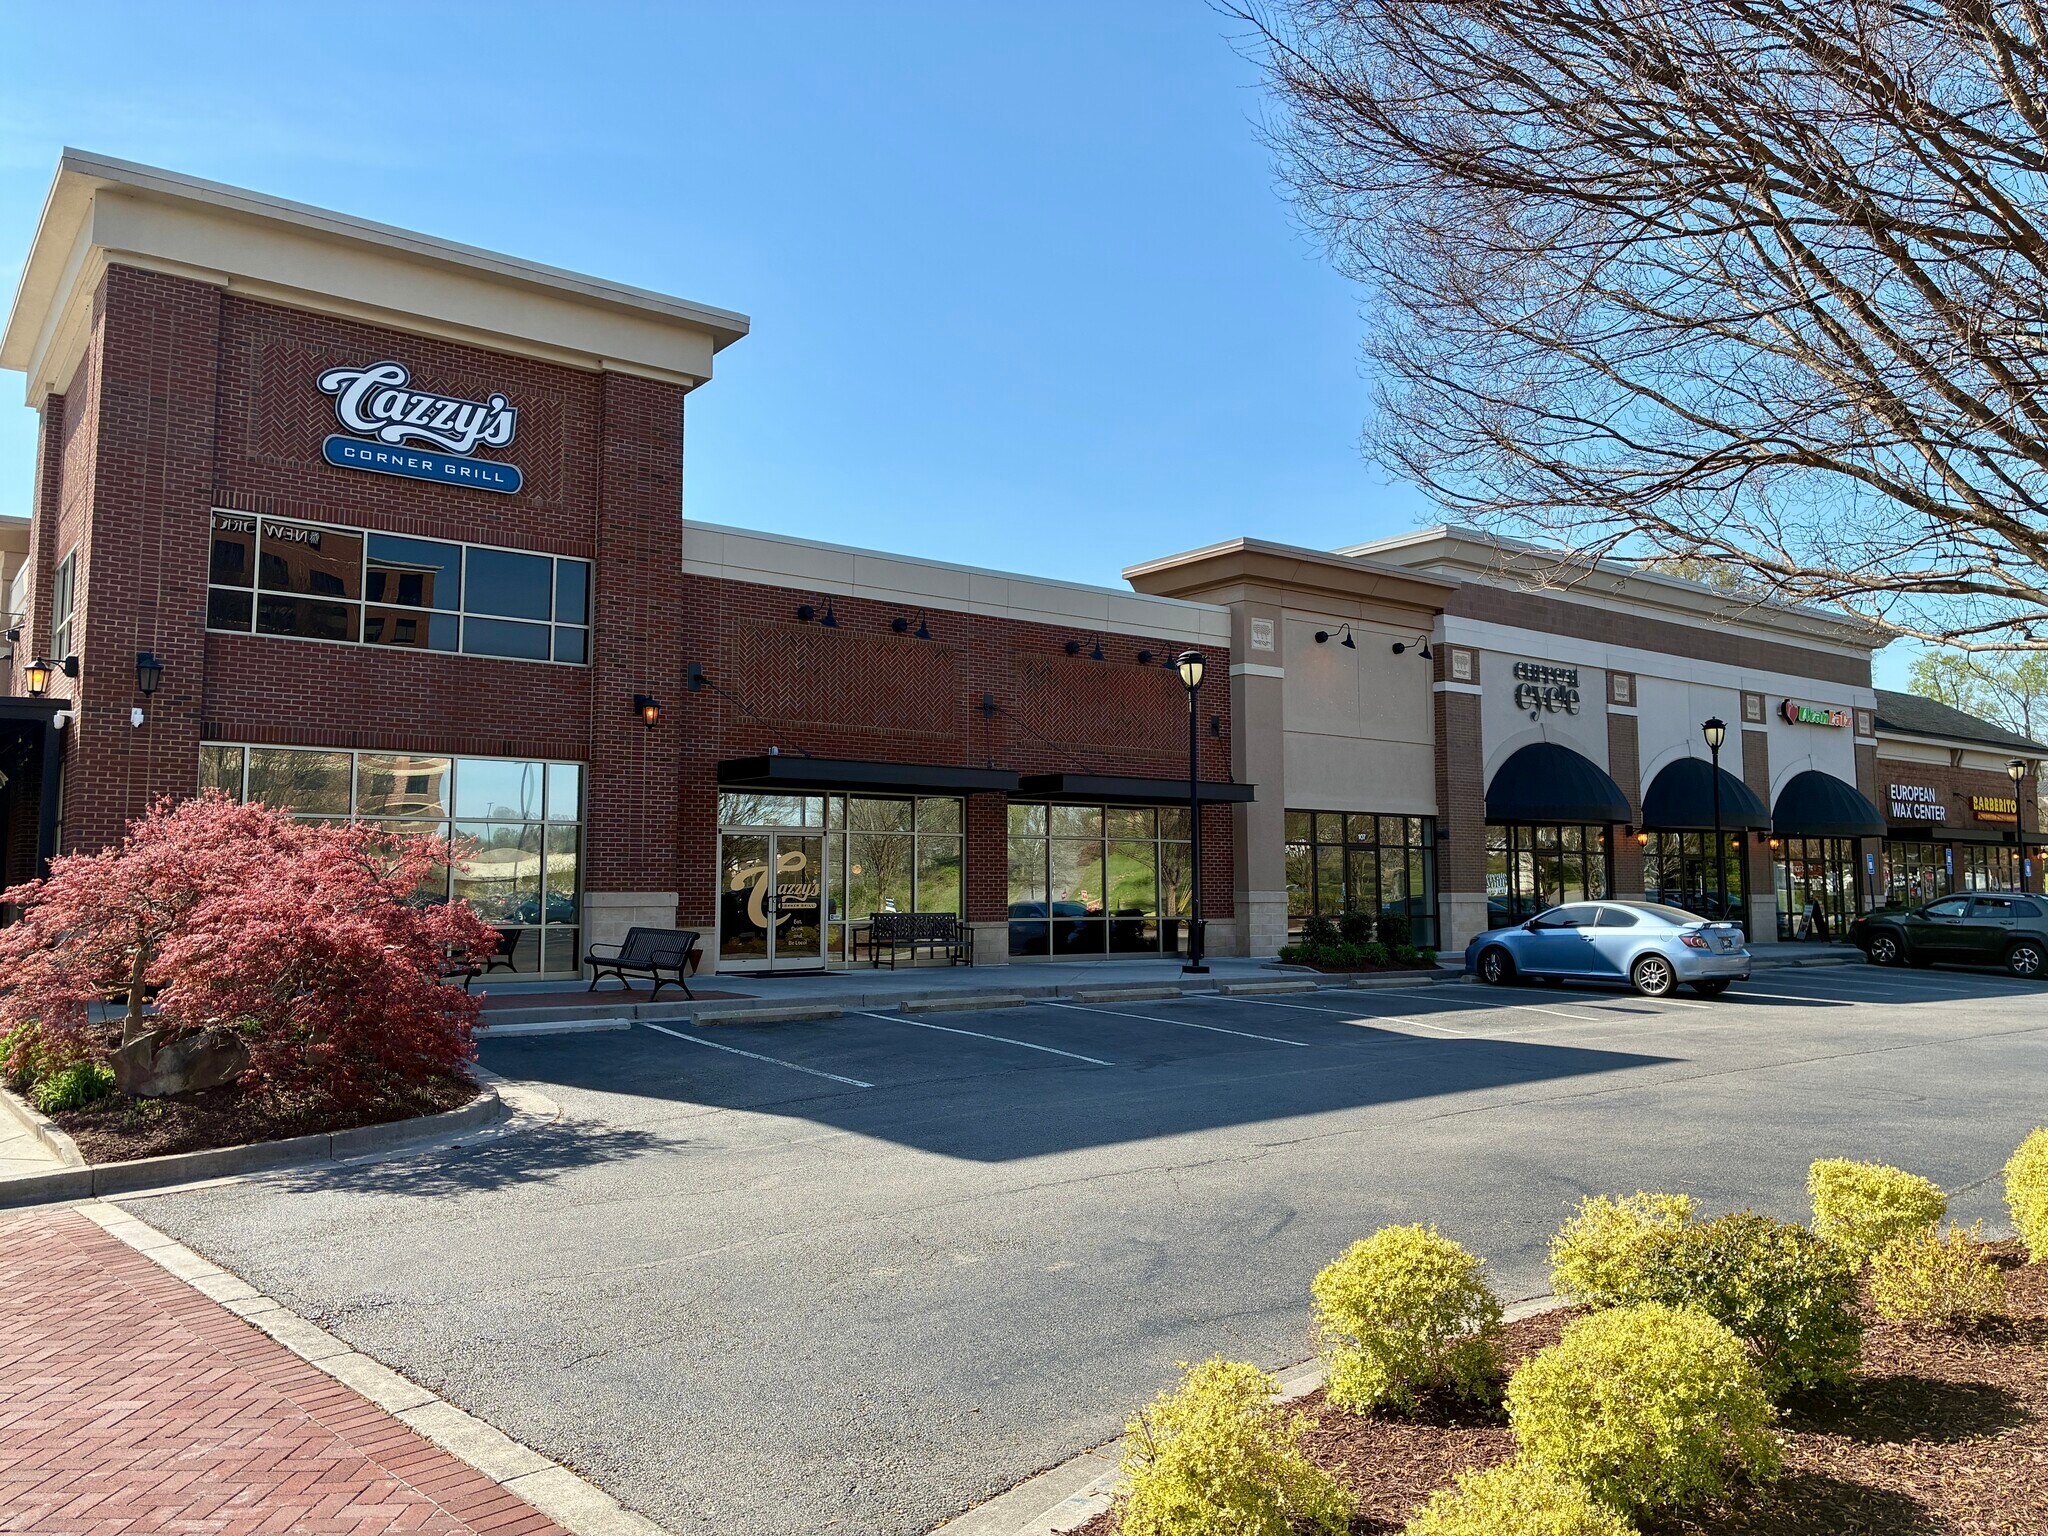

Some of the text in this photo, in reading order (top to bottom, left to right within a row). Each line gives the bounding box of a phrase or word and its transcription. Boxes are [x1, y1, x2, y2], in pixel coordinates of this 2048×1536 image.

[320, 364, 514, 453] Cazzy's
[344, 447, 504, 483] CORNER GRILL
[1514, 683, 1580, 722] cycle
[1890, 783, 1936, 803] EUROPEAN
[1972, 795, 2017, 814] BARBERITO
[1891, 801, 1946, 821] WAX CENTER
